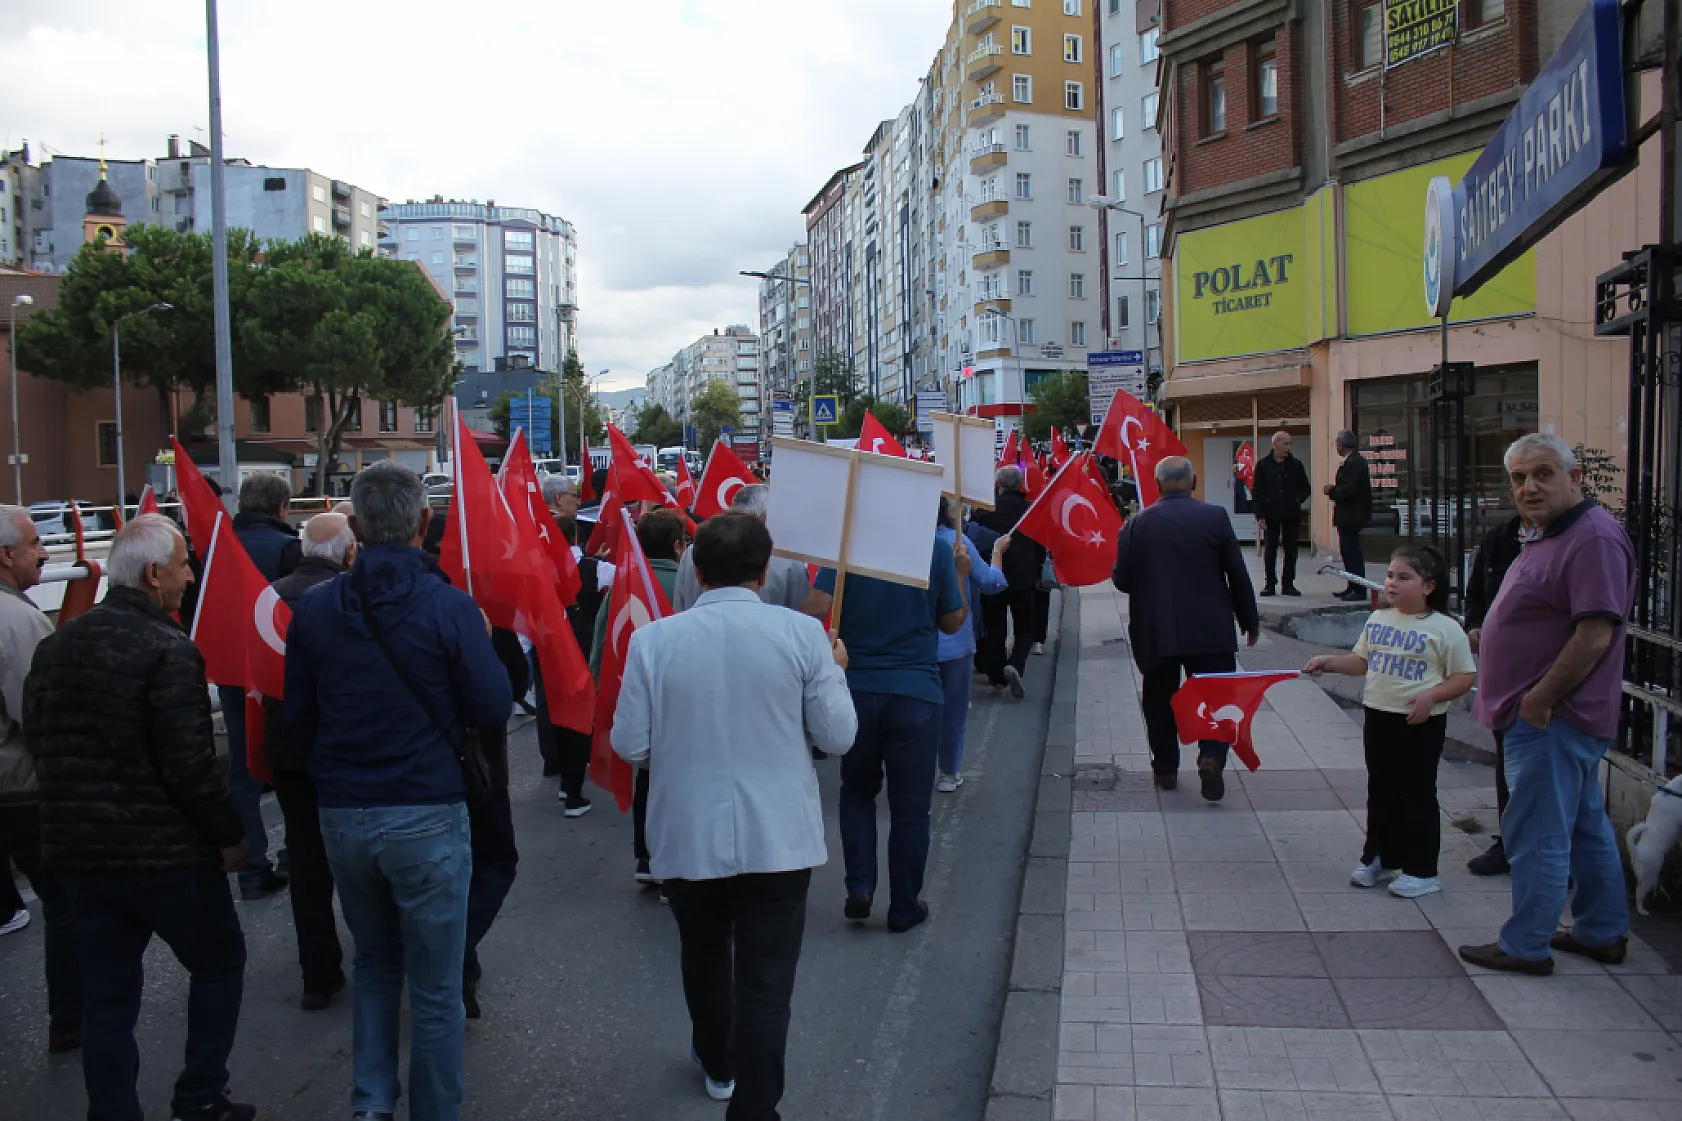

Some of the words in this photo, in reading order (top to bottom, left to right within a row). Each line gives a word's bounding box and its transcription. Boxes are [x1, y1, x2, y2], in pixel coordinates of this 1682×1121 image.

[1522, 57, 1592, 201] PARKI
[1193, 253, 1294, 299] POLAT
[1212, 292, 1273, 315] TİCARET
